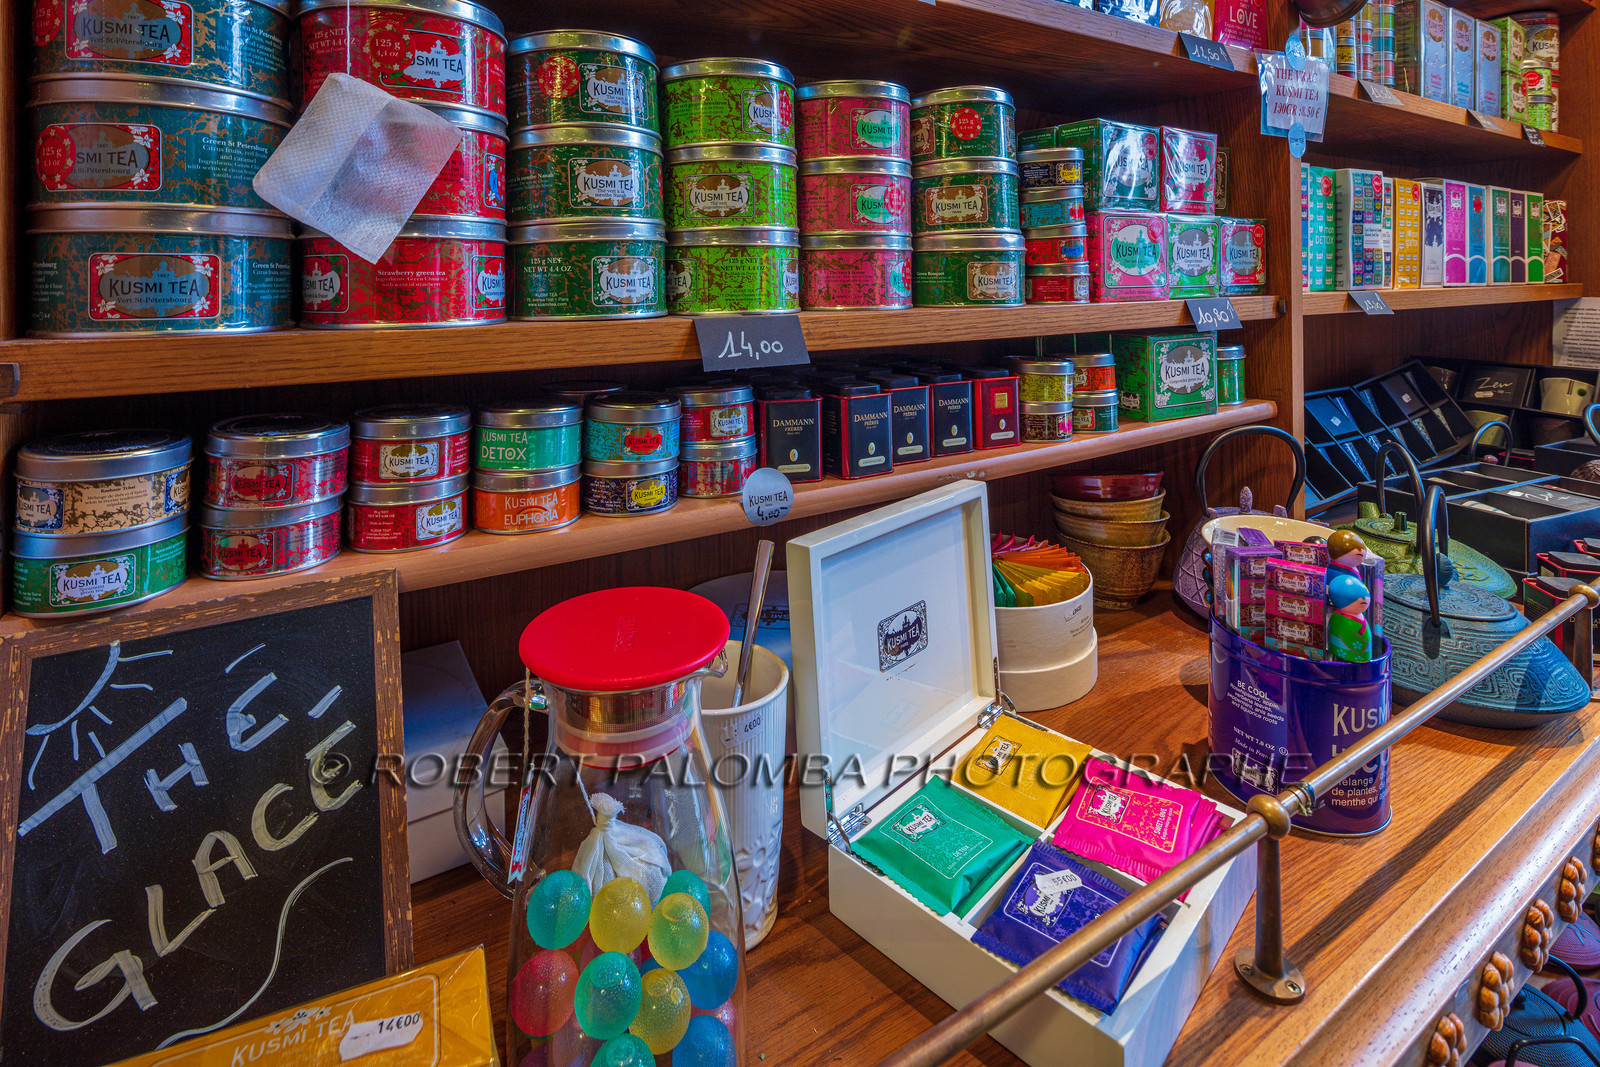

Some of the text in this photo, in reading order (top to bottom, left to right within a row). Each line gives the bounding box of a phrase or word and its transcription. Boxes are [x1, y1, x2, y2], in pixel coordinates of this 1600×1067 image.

[1230, 6, 1258, 29] LOVE
[84, 18, 169, 43] KUSMI TEA
[329, 28, 345, 36] NET
[375, 38, 400, 50] 125 g
[1192, 44, 1219, 62] 12,50
[442, 59, 463, 75] TEA
[1275, 68, 1293, 81] THE
[593, 83, 624, 96] KUSMI
[1276, 84, 1319, 101] KUSMI TEA
[861, 124, 885, 135] KUSMI
[914, 133, 928, 143] TEA
[202, 137, 226, 146] Green
[236, 141, 268, 154] Petersburg
[203, 144, 219, 152] Citrus
[107, 150, 138, 168] TEA
[234, 155, 257, 163] caramel
[1197, 163, 1207, 177] TEA
[584, 177, 616, 190] KUSMI
[695, 191, 743, 204] KUSMI TEA
[936, 201, 978, 213] KUSMI TEA
[1315, 236, 1334, 245] DETOX
[1143, 243, 1156, 259] TEA
[1176, 246, 1210, 260] KUSMI TEA
[1230, 247, 1259, 260] KUSMI TEA
[109, 278, 199, 298] KUSMI TEA
[318, 277, 334, 293] TEA
[606, 276, 650, 290] KUSMI TEA
[675, 276, 687, 287] TEA
[978, 276, 1001, 287] KUSMI
[1198, 306, 1230, 327] 10,80
[718, 331, 784, 361] 14,00
[1165, 362, 1205, 380] KUSMI TEA
[1478, 377, 1514, 389] Zen
[938, 397, 968, 407] DAMMANN
[893, 404, 926, 414] DAMMANN
[718, 419, 734, 428] KUSMI
[773, 419, 814, 428] DAMMANN
[854, 412, 888, 423] DAMMANN
[482, 430, 528, 444] KUSMI TEA
[628, 437, 648, 446] KUSMI
[481, 446, 527, 460] DETOX
[390, 457, 429, 467] KUSMI TEA
[234, 479, 281, 489] KUSMI TEA
[634, 487, 663, 499] KUSMI TEA
[748, 490, 788, 507] KUSMI TEA
[505, 492, 558, 510] KUSMI TEA
[36, 504, 50, 515] TEA
[426, 510, 458, 527] KUSMI TEA
[504, 509, 558, 526] EUPHORIA
[246, 549, 261, 558] TEA
[63, 572, 121, 592] KUSMI TEA
[1281, 577, 1307, 588] KUSMI TEA
[1281, 602, 1307, 613] KUSMI TEA
[887, 624, 920, 652] KUSMI TEA
[1280, 626, 1306, 638] KUSMI TEA
[1230, 683, 1280, 710] Rosehipseed, apple,
[1237, 680, 1270, 700] BE COOL
[1235, 692, 1273, 713] verbena leaves,
[1263, 716, 1278, 725] roots
[1267, 711, 1284, 722] seeds
[744, 717, 761, 733] 4€00
[1233, 726, 1275, 751] NET WT OZ
[1235, 738, 1248, 749] Made
[1332, 788, 1345, 796] de
[1332, 798, 1366, 806] menthe
[1159, 808, 1167, 818] LOVE
[906, 813, 933, 833] KUSMI TEA
[952, 844, 969, 857] DETOX
[1052, 874, 1077, 885] 55€00
[378, 1011, 421, 1035] 14€00
[231, 1009, 355, 1067] KUSMI TEA
